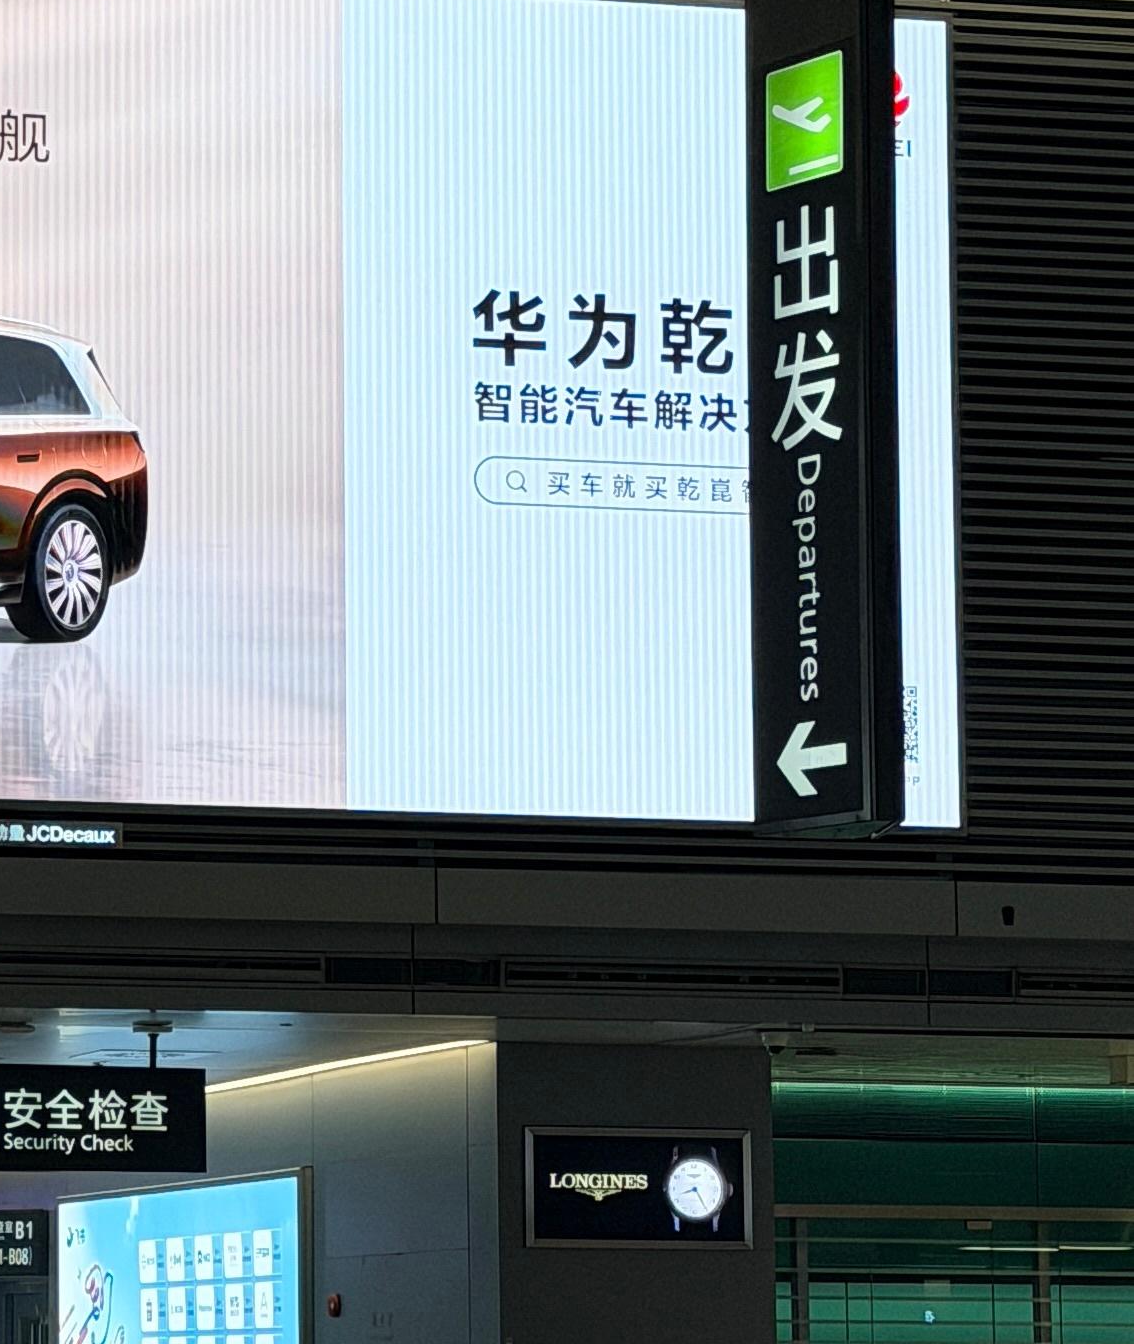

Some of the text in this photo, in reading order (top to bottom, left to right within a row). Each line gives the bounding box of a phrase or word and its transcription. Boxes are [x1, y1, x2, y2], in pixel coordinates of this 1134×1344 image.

[771, 203, 843, 452] 出发
[474, 381, 751, 434] 智能汽车解决
[792, 454, 824, 703] Departures
[26, 824, 116, 844] JCDecaux
[3, 1089, 170, 1132] 安全检查
[3, 1132, 75, 1155] Security
[81, 1133, 134, 1152] Check
[549, 1172, 648, 1191] LONGINES
[15, 1221, 33, 1240] B1
